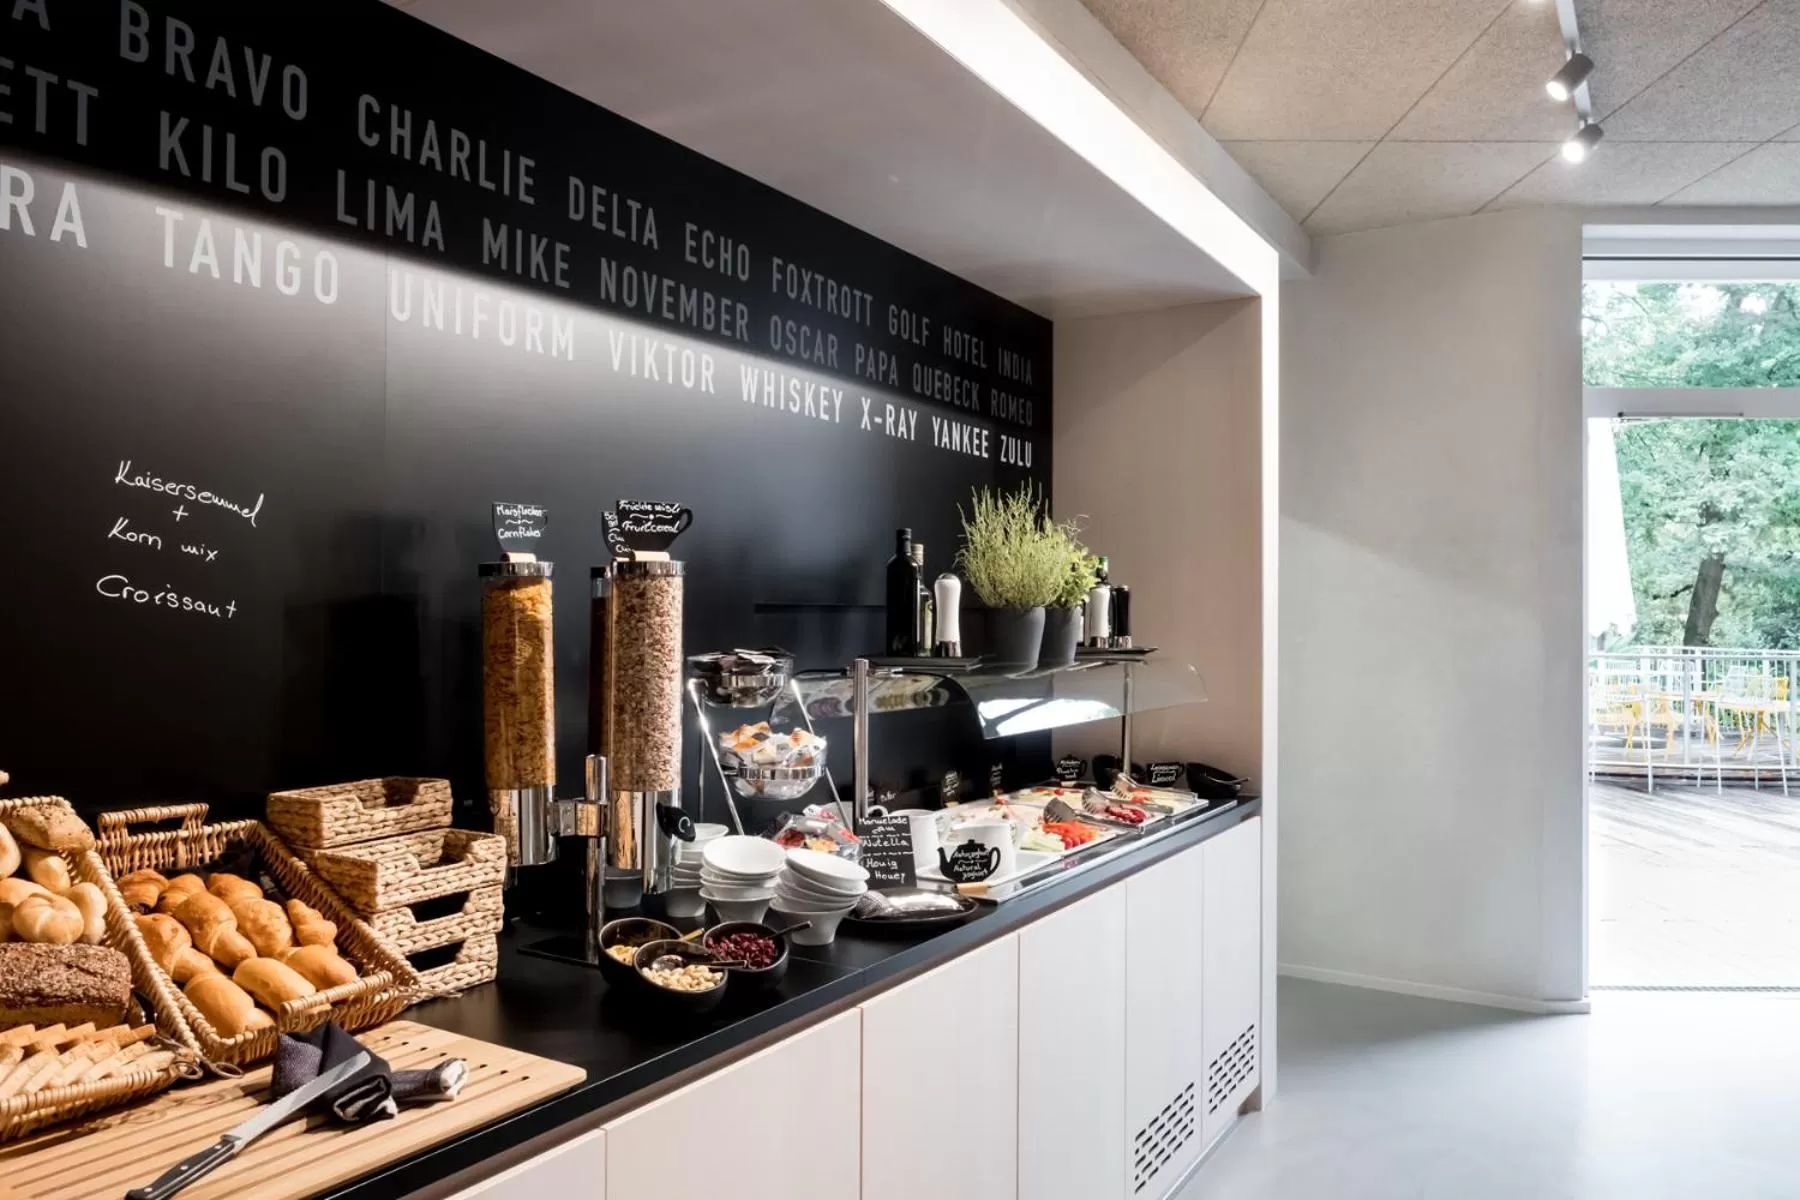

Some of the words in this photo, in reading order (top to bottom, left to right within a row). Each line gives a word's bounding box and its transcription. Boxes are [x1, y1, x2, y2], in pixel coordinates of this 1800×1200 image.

[119, 0, 308, 120] BRAVO
[357, 94, 535, 204] CHARLIE
[569, 176, 659, 249] DELTA
[685, 222, 750, 282] ECHO
[772, 257, 873, 327] FOXTROTT
[889, 304, 930, 347] GOLF
[943, 326, 987, 369] HOTEL
[998, 347, 1034, 386] INDIA
[155, 206, 339, 304] TANGO
[390, 267, 574, 361] UNIFORM
[608, 329, 715, 395] VIKTOR
[740, 363, 843, 424] WHISKEY
[860, 396, 917, 441] X-RAY
[932, 415, 989, 459] YANKEE
[1000, 434, 1033, 468] ZULU
[159, 111, 287, 203] KILO
[337, 169, 445, 252] LIMA
[483, 218, 571, 289] MIKE
[600, 257, 749, 343] NOVEMBER
[770, 315, 838, 369] OSCAR
[855, 344, 898, 387] PAPA
[913, 362, 980, 411] QUEBECK
[990, 389, 1033, 428] ROMEO
